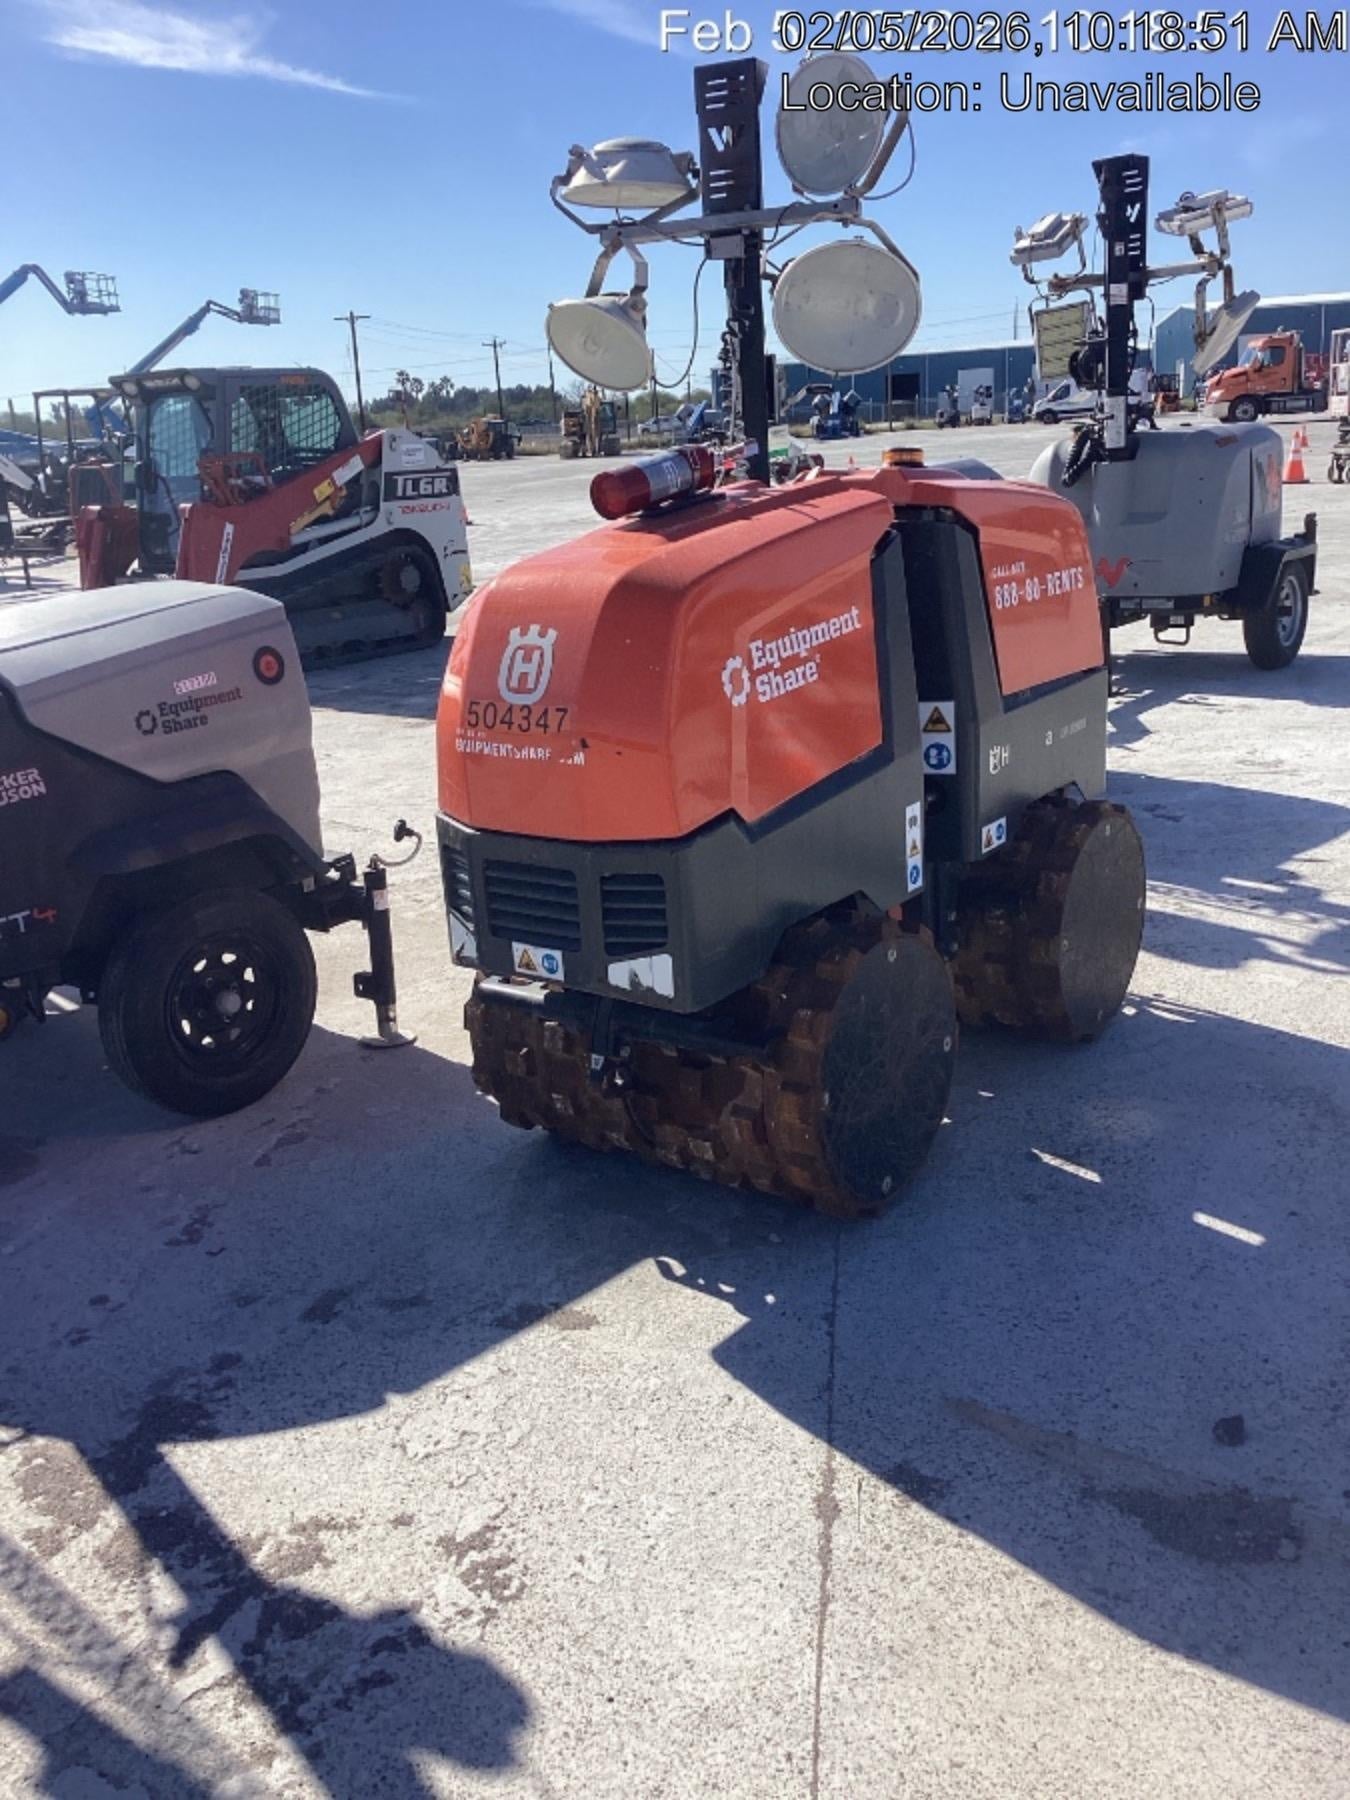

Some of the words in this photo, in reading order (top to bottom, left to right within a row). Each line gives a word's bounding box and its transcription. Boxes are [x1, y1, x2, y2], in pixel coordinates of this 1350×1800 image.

[995, 566, 1084, 610] 888-80-RENTS
[750, 605, 861, 671] Equipment
[756, 660, 819, 703] Share
[157, 687, 242, 718] Equipment
[467, 701, 569, 735] 504347
[161, 714, 209, 735] Share
